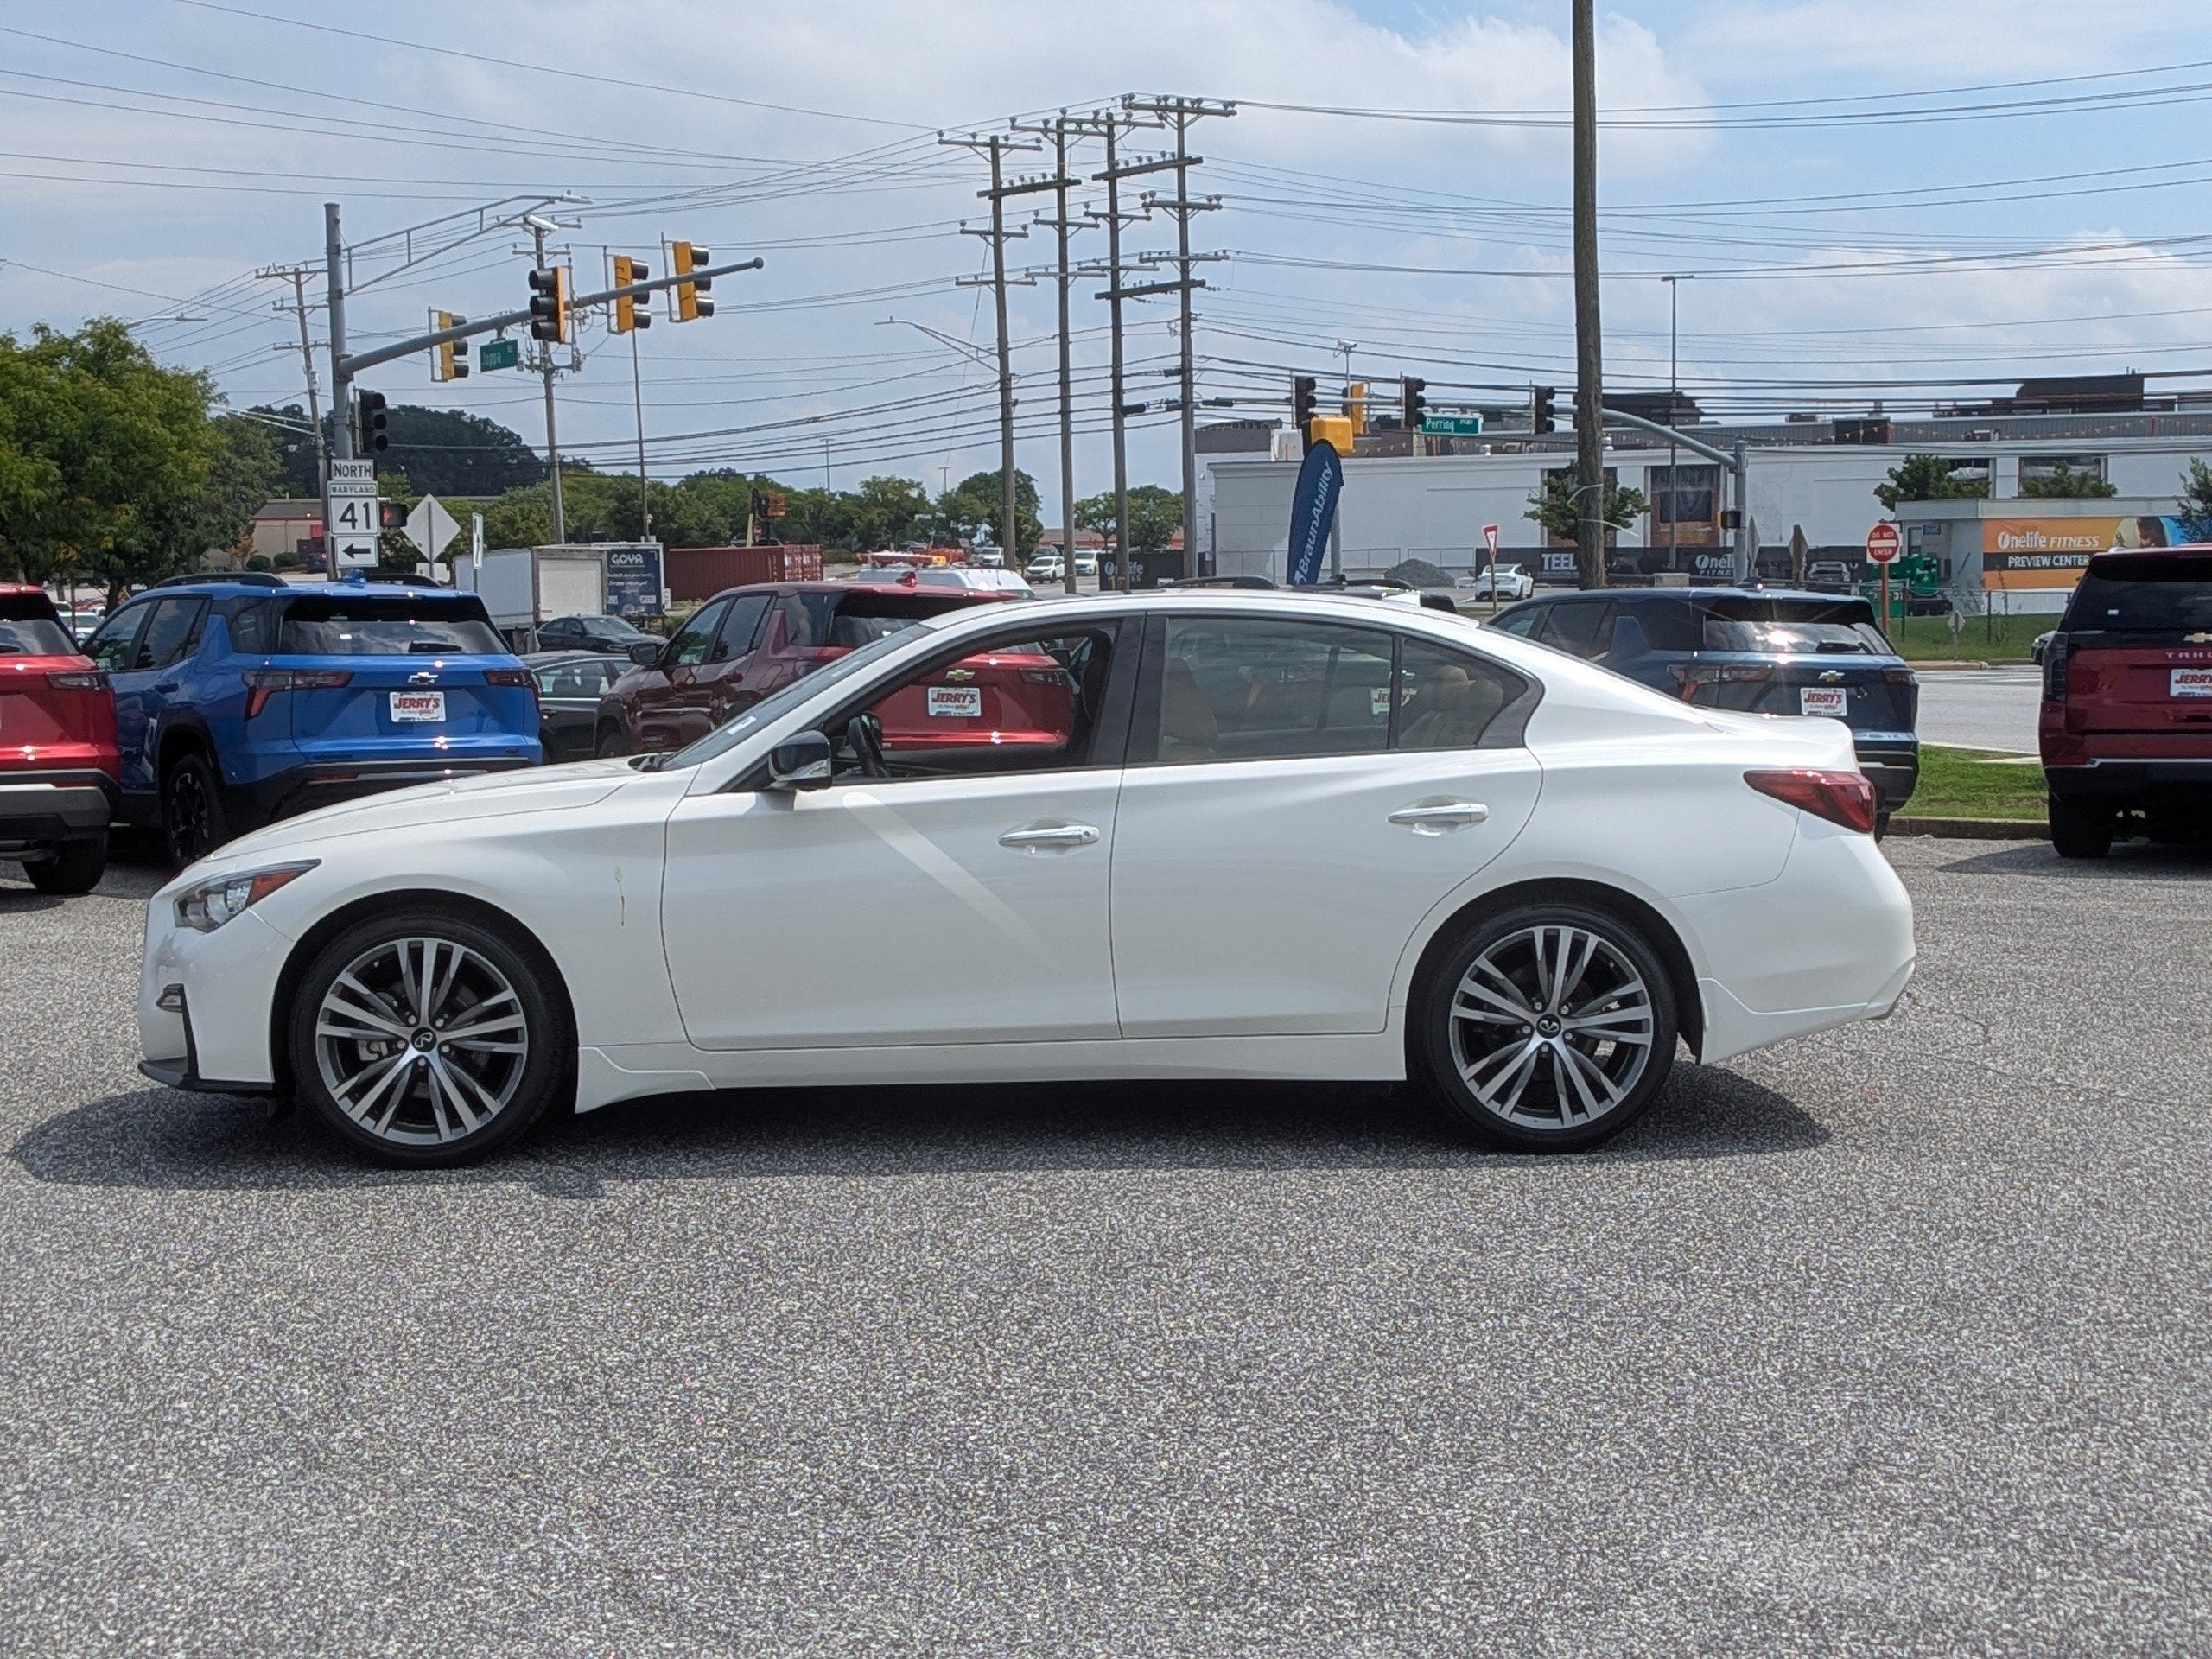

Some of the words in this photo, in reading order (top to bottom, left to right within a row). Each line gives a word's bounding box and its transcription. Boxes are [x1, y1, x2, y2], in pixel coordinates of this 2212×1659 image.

[1426, 417, 1454, 432] Perring
[334, 463, 372, 478] NORTH
[339, 502, 371, 530] 41
[1298, 461, 1333, 575] BraunAbility
[1997, 531, 2046, 550] Onelife
[2050, 536, 2099, 548] FITNESS
[2008, 556, 2050, 568] PREVIEW
[2052, 554, 2090, 566] CENTER
[393, 697, 441, 709] JERRY'S
[932, 692, 976, 703] JERRY'S
[1804, 693, 1843, 703] JERRY'S
